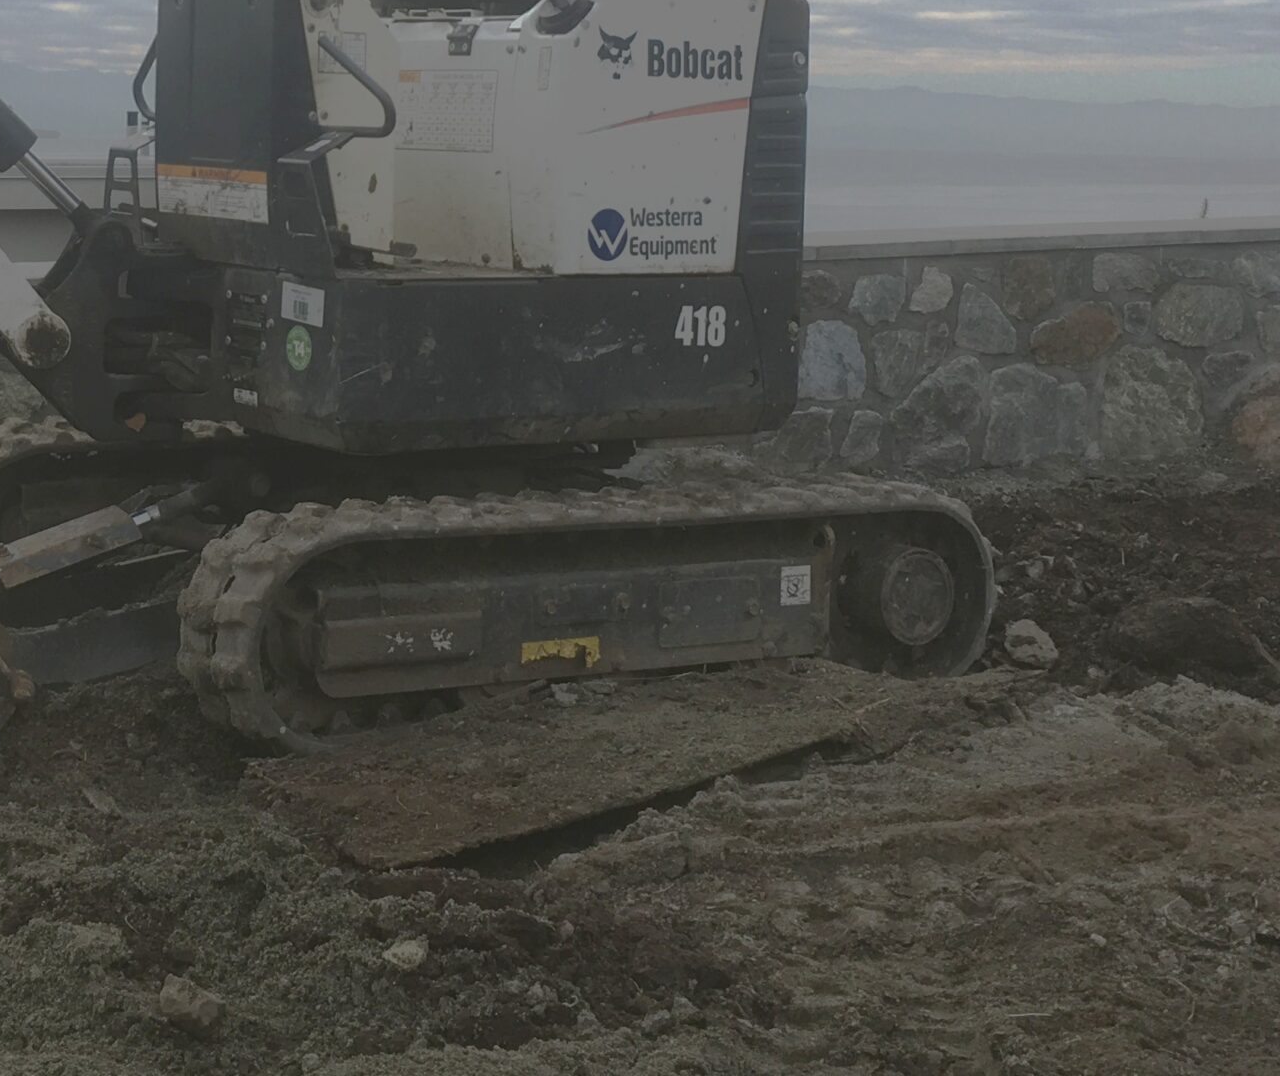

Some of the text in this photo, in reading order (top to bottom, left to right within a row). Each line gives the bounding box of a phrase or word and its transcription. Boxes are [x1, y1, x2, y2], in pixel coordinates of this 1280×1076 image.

[647, 39, 743, 81] Bobcat
[630, 207, 702, 227] Westerra
[630, 235, 717, 260] Equipment
[674, 305, 726, 347] 418
